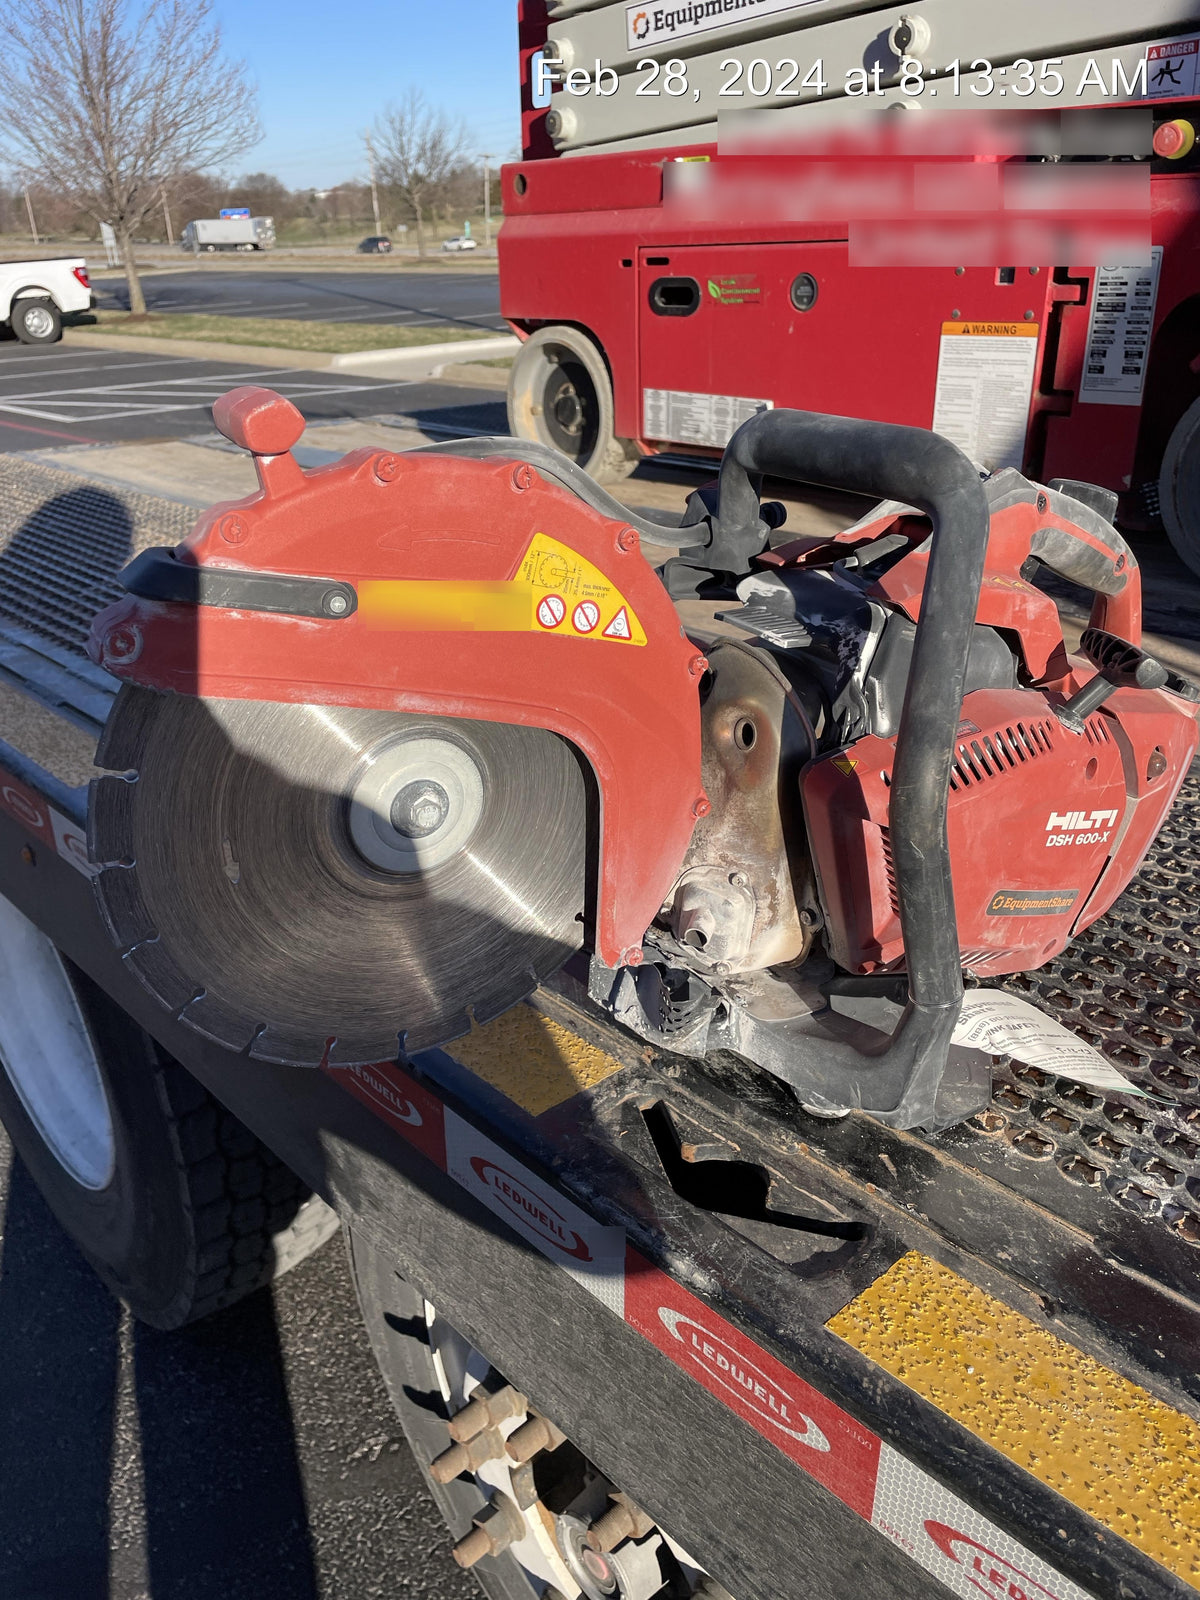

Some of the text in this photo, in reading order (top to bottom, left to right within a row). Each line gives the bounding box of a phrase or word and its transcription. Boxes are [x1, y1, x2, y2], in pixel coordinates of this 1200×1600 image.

[653, 0, 766, 31] Equipmen
[1160, 43, 1195, 57] DANGER
[971, 324, 1018, 336] WARNING
[1045, 809, 1119, 831] HILTI
[1046, 831, 1111, 847] DSH 600-X
[1003, 896, 1074, 911] EquipmentShare
[1006, 1021, 1042, 1032] SAFETY
[494, 1175, 566, 1241] LEDWELL
[691, 1332, 792, 1423] LEDWELL
[973, 1555, 1034, 1600] LED
